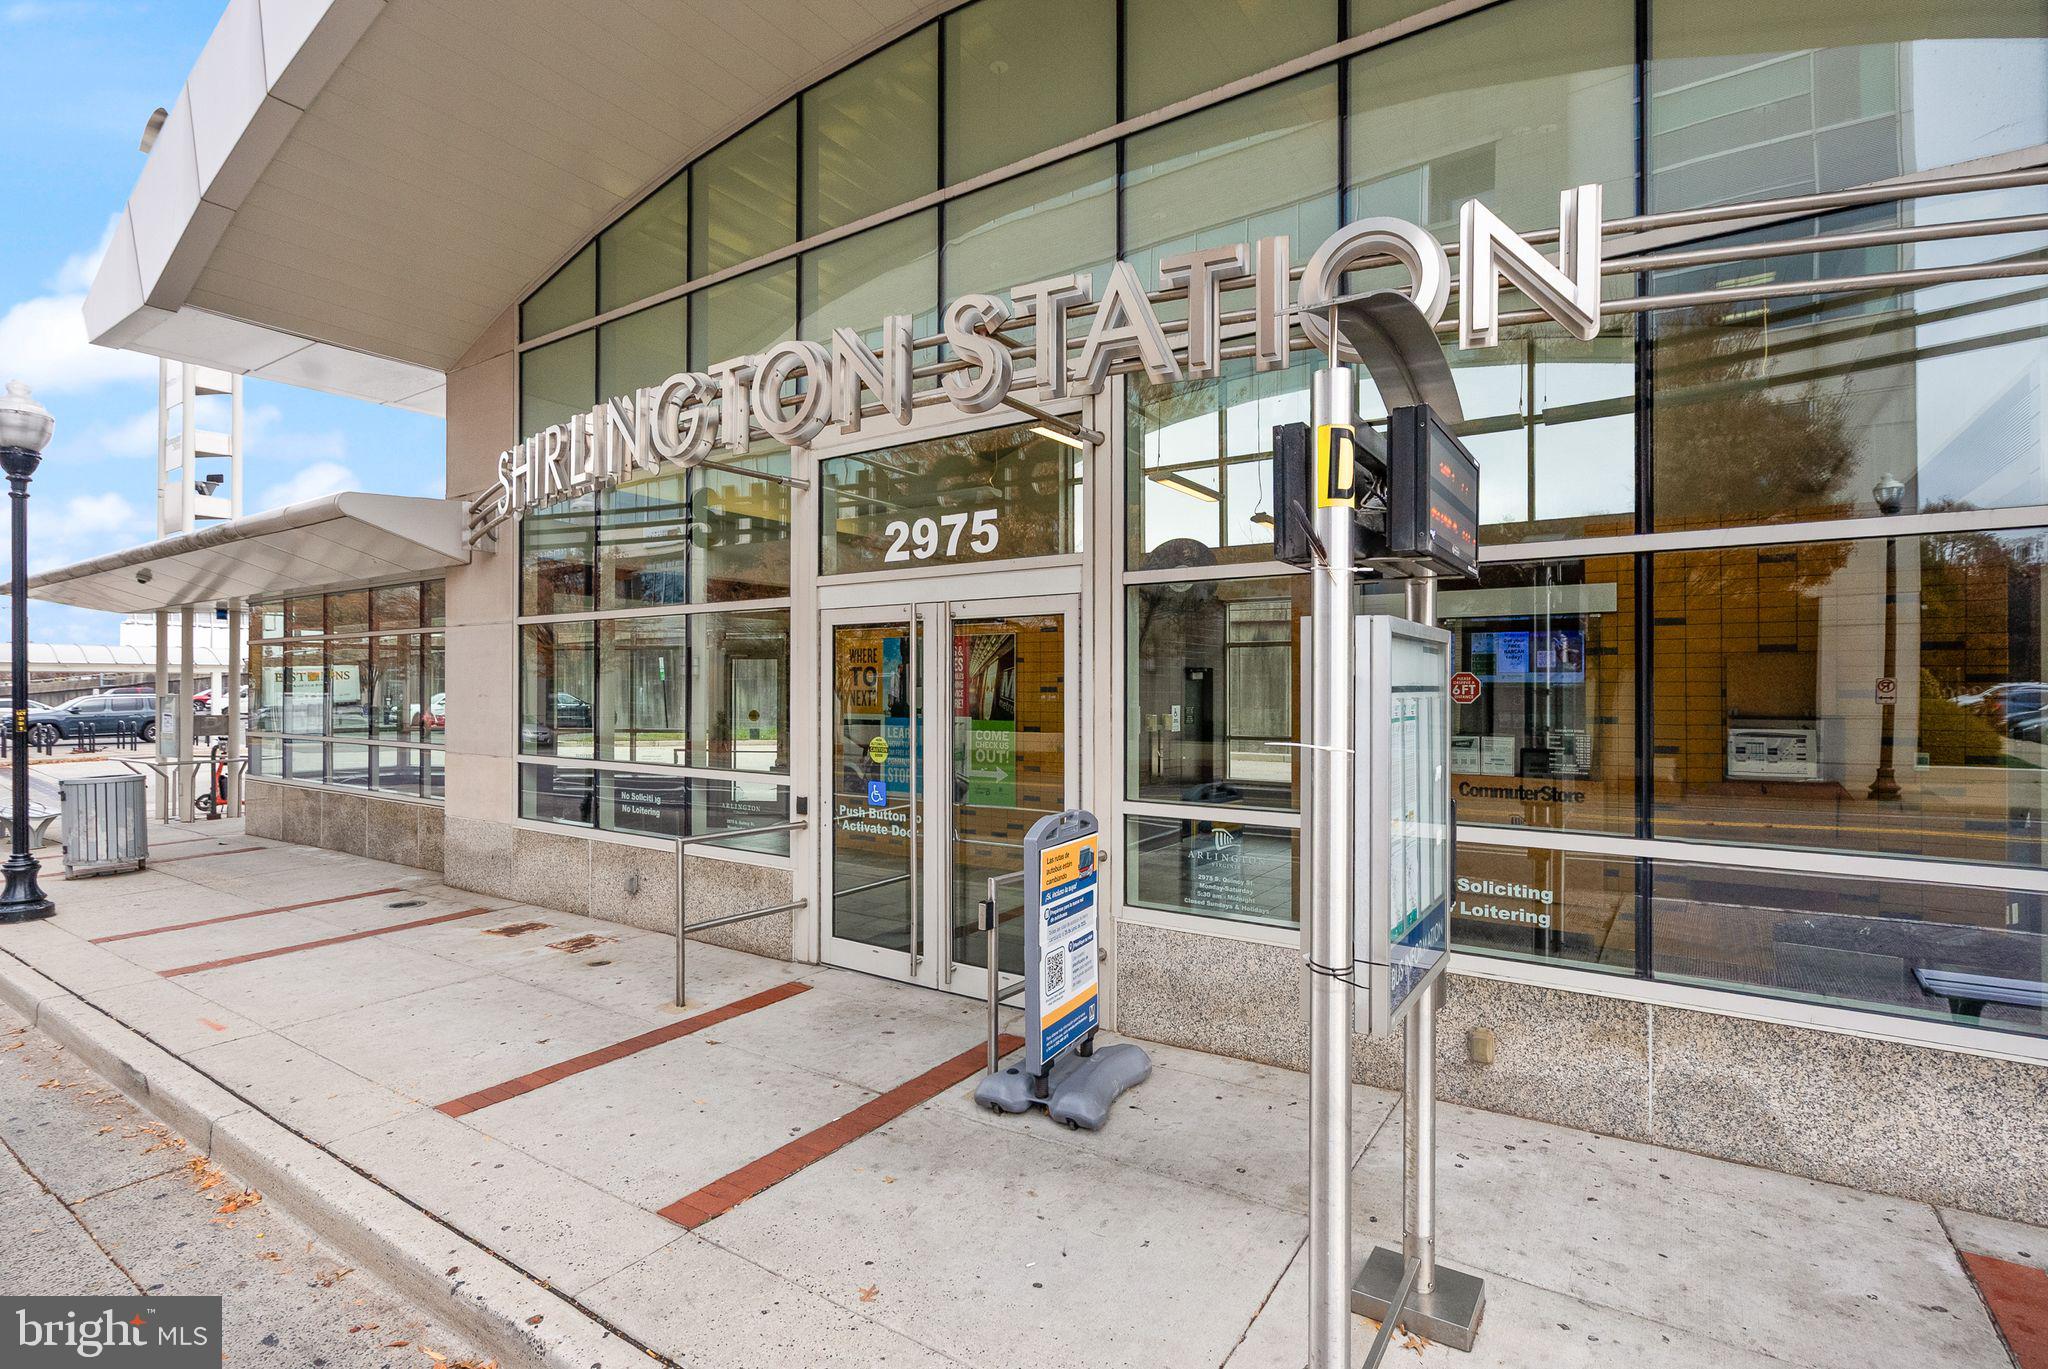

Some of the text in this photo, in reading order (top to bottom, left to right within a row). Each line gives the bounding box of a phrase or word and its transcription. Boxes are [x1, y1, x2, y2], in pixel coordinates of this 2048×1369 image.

[498, 184, 1602, 518] SHIRLINGTON STATION
[1327, 427, 1354, 499] D
[884, 508, 999, 562] 2975
[849, 648, 878, 663] WHERE
[849, 666, 877, 687] TO
[1452, 684, 1476, 695] 6 FT
[850, 690, 876, 707] NEXT?
[887, 727, 911, 738] LEAR
[976, 731, 1009, 741] COME
[1000, 742, 1009, 750] US
[976, 749, 1009, 764] OUT!
[621, 791, 630, 800] No
[622, 804, 660, 818] No Loitering
[721, 802, 761, 812] ARLINGTON
[839, 804, 866, 818] Push
[868, 807, 907, 822] Button
[842, 819, 919, 838] Activate Doo
[1188, 850, 1266, 866] ARLINGTON
[1199, 883, 1254, 895] Monday-Saturday
[1457, 877, 1554, 905] Soliciting
[1184, 897, 1206, 906] Closed
[1206, 901, 1233, 910] Sundays
[1241, 905, 1270, 915] Holidays
[1227, 895, 1256, 904] Midnight
[1460, 901, 1551, 928] Loitering
